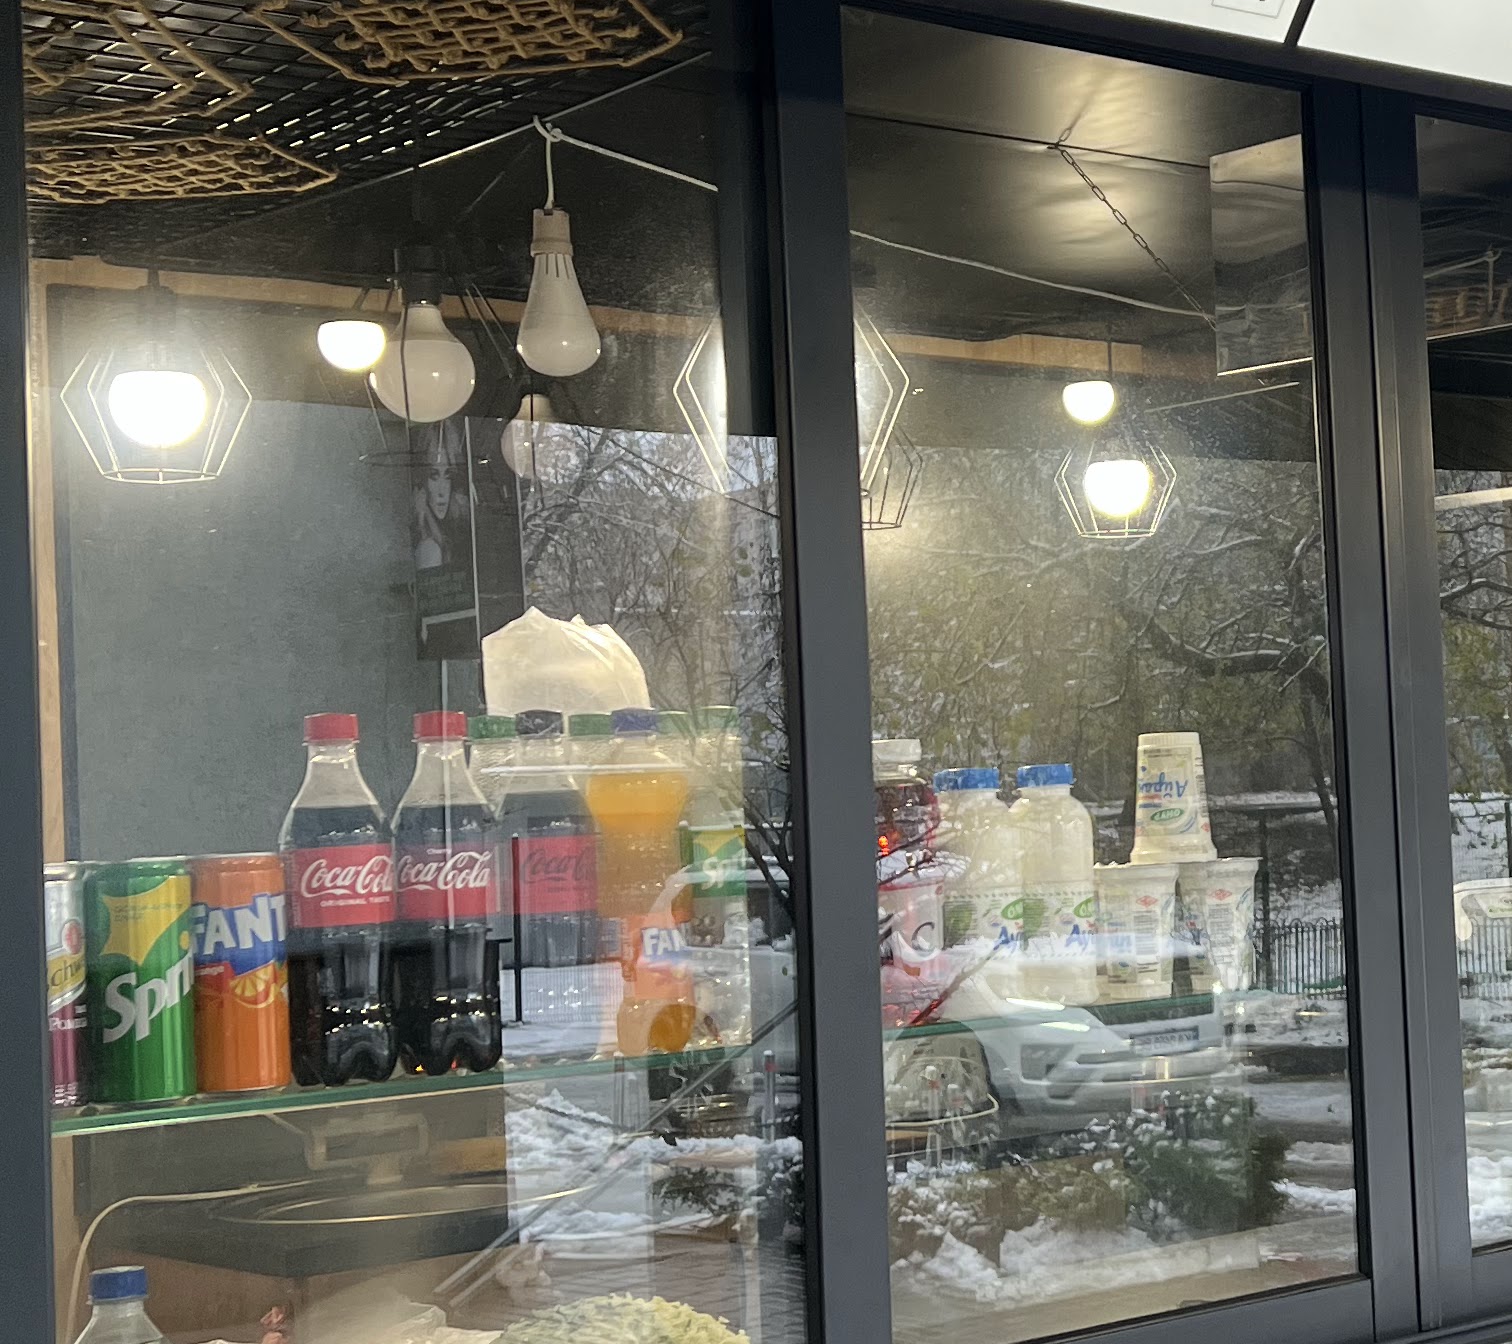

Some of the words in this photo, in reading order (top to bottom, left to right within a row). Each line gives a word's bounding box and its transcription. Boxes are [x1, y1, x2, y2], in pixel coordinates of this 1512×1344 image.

[302, 855, 393, 898] Coca-Col
[191, 895, 286, 955] FANT
[103, 931, 194, 1043] Spri
